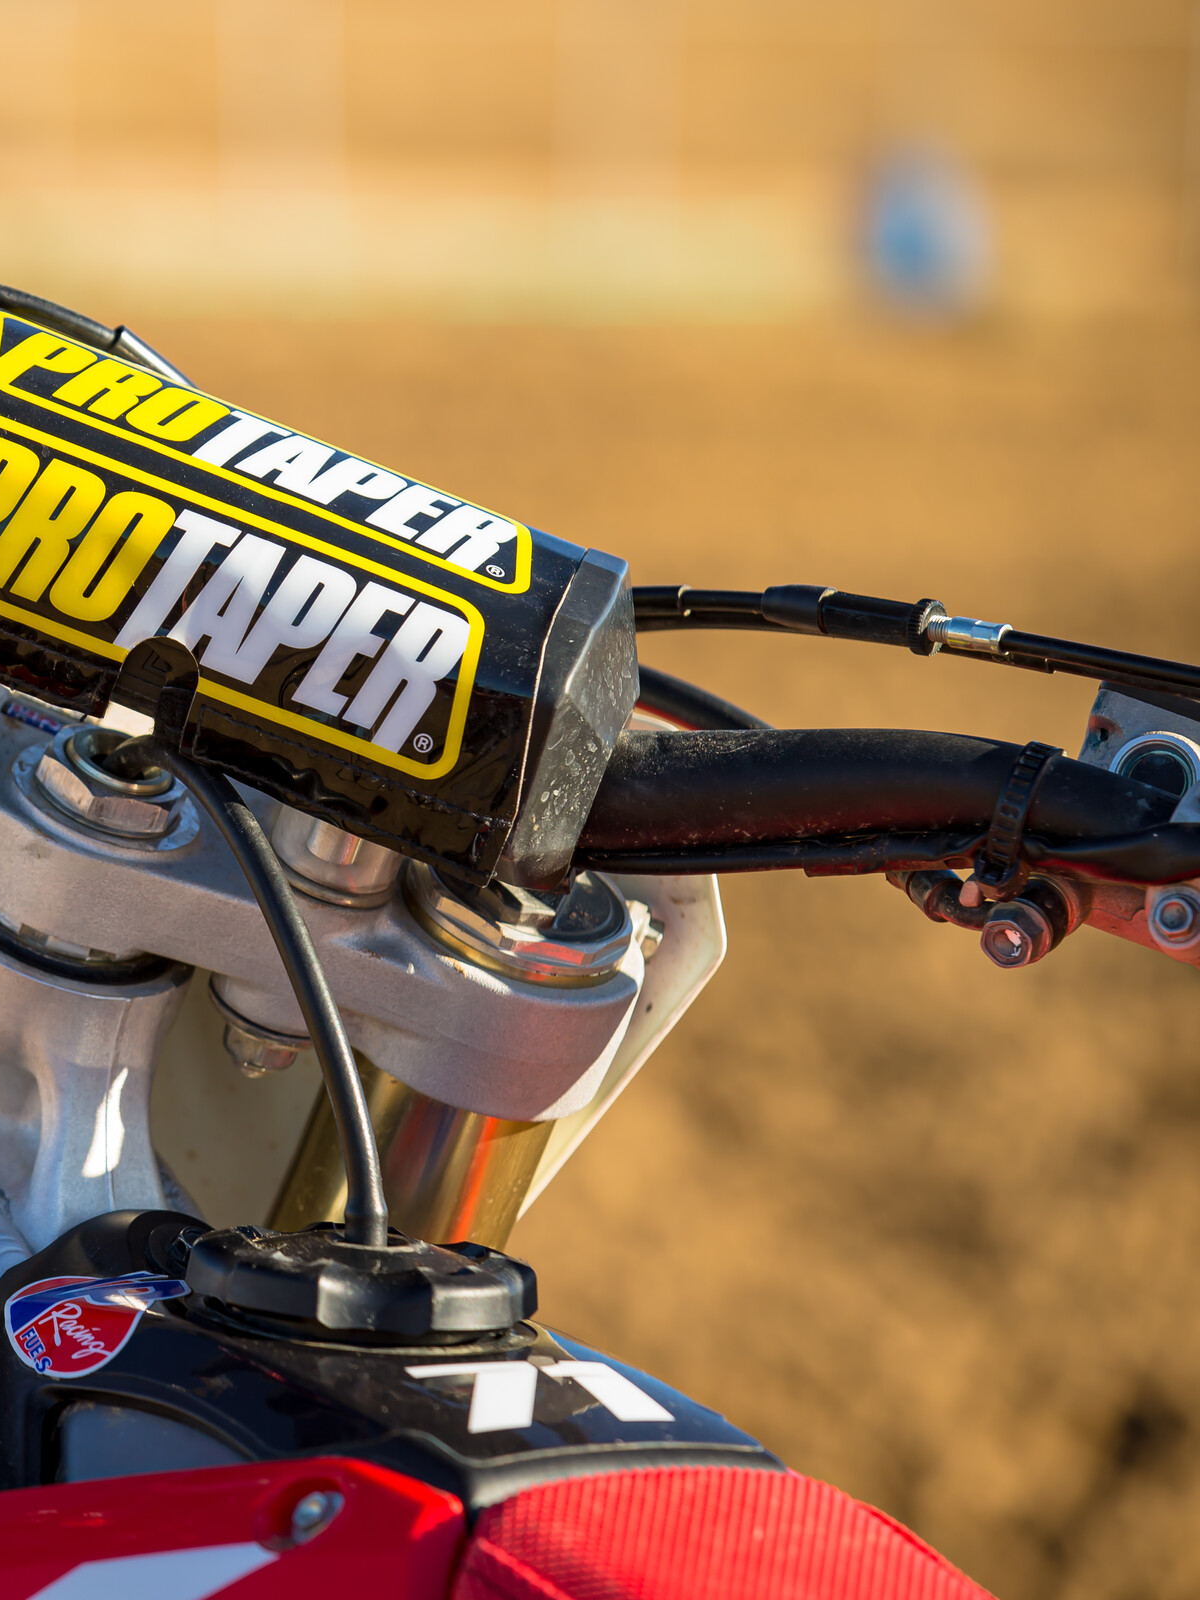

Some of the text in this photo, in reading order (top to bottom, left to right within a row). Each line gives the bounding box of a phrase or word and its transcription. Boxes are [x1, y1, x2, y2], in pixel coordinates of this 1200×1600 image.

[19, 1325, 53, 1375] FUES
[38, 1303, 113, 1360] Racing
[403, 1359, 676, 1434] 71
